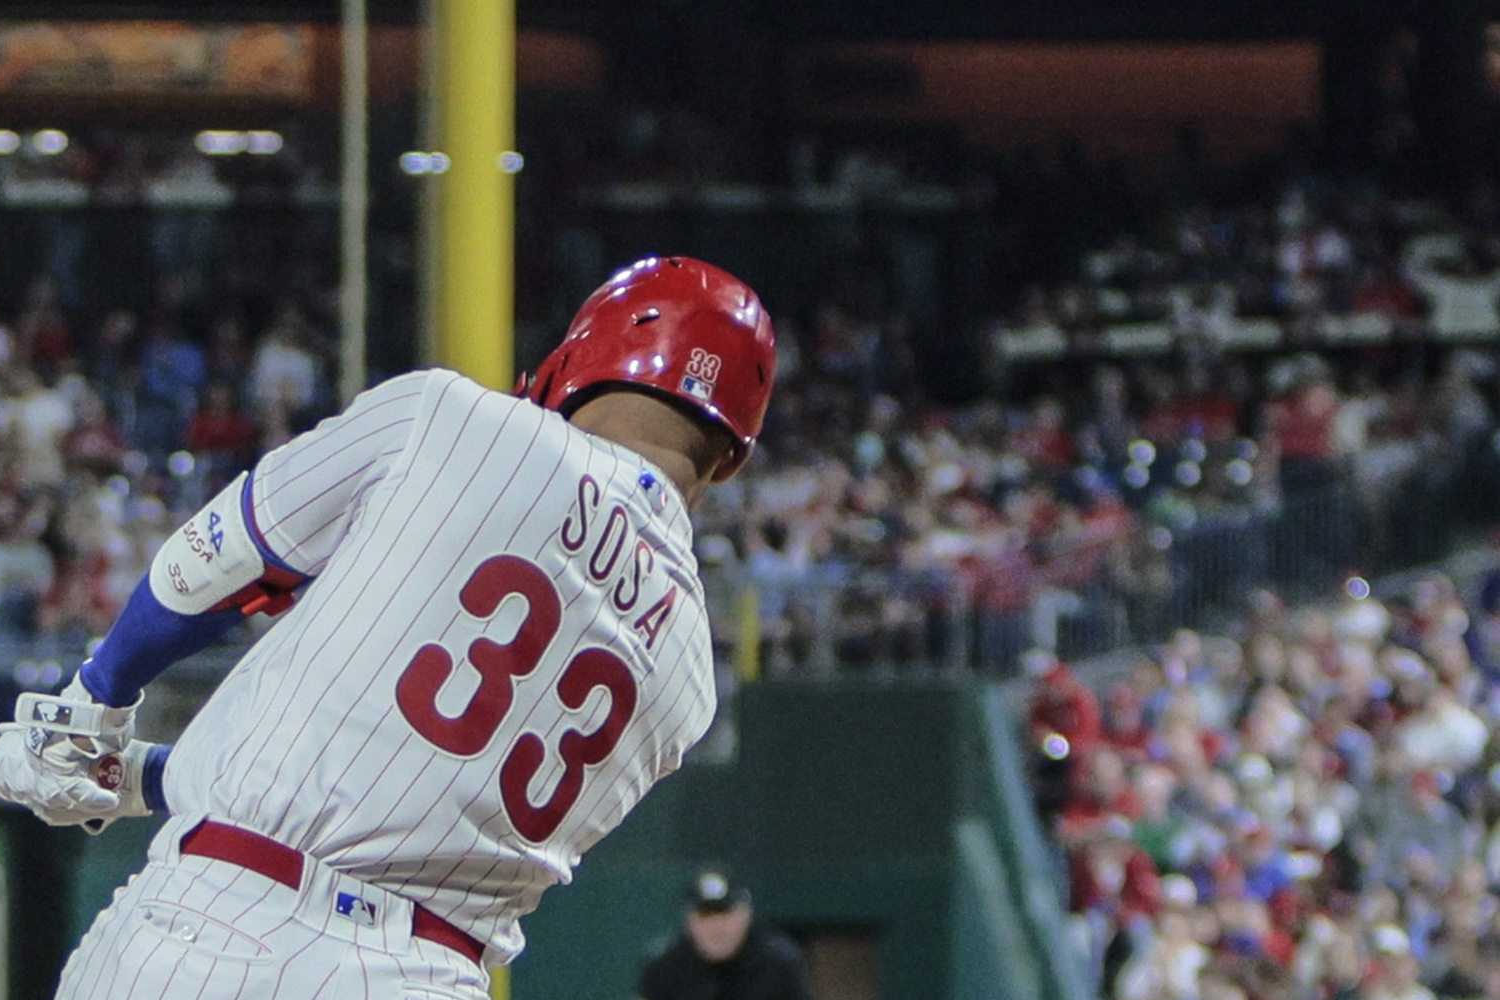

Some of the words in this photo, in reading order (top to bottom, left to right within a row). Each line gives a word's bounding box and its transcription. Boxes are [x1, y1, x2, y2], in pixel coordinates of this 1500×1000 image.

[687, 348, 722, 384] 33
[182, 521, 214, 564] SOSA
[561, 473, 678, 650] SOSA
[168, 562, 190, 594] 33
[396, 553, 639, 844] 33
